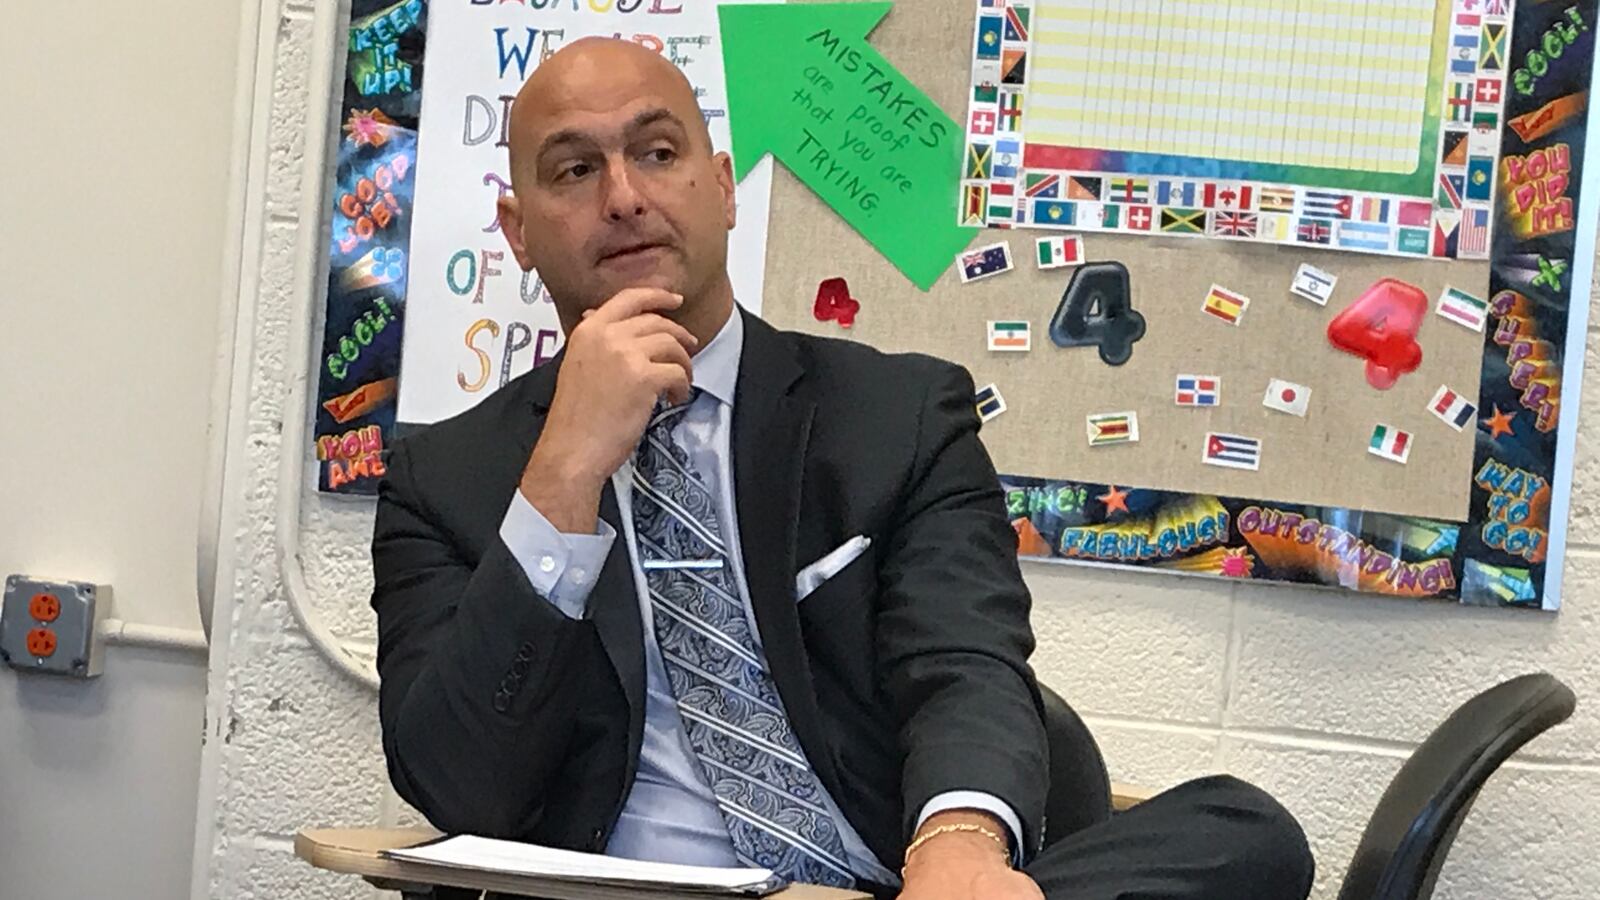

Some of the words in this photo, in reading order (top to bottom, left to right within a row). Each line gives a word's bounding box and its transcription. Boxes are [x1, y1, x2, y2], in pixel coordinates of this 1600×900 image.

[355, 0, 422, 52] KEEP
[1513, 5, 1589, 96] COOL!
[374, 42, 399, 68] IT
[364, 65, 413, 96] UP!
[805, 28, 947, 149] MISTAKES
[803, 65, 835, 94] are
[846, 104, 910, 152] proof
[792, 88, 835, 125] that
[838, 130, 876, 162] you
[880, 165, 913, 194] are
[1504, 143, 1571, 182] YOU
[1513, 172, 1569, 213] DID
[1531, 197, 1574, 233] IT!
[447, 249, 504, 304] OF
[814, 277, 860, 329] 4
[1049, 260, 1146, 366] 4
[327, 296, 396, 380] COOL!
[1327, 278, 1428, 390] 4
[318, 425, 382, 461] YOU
[1007, 484, 1088, 515] ZING!
[1475, 458, 1546, 499] WAY
[1488, 493, 1530, 526] TO
[1060, 511, 1230, 560] FABULOUS!
[1238, 506, 1456, 593] OUTSTANDING!
[1482, 520, 1544, 561] GO!
